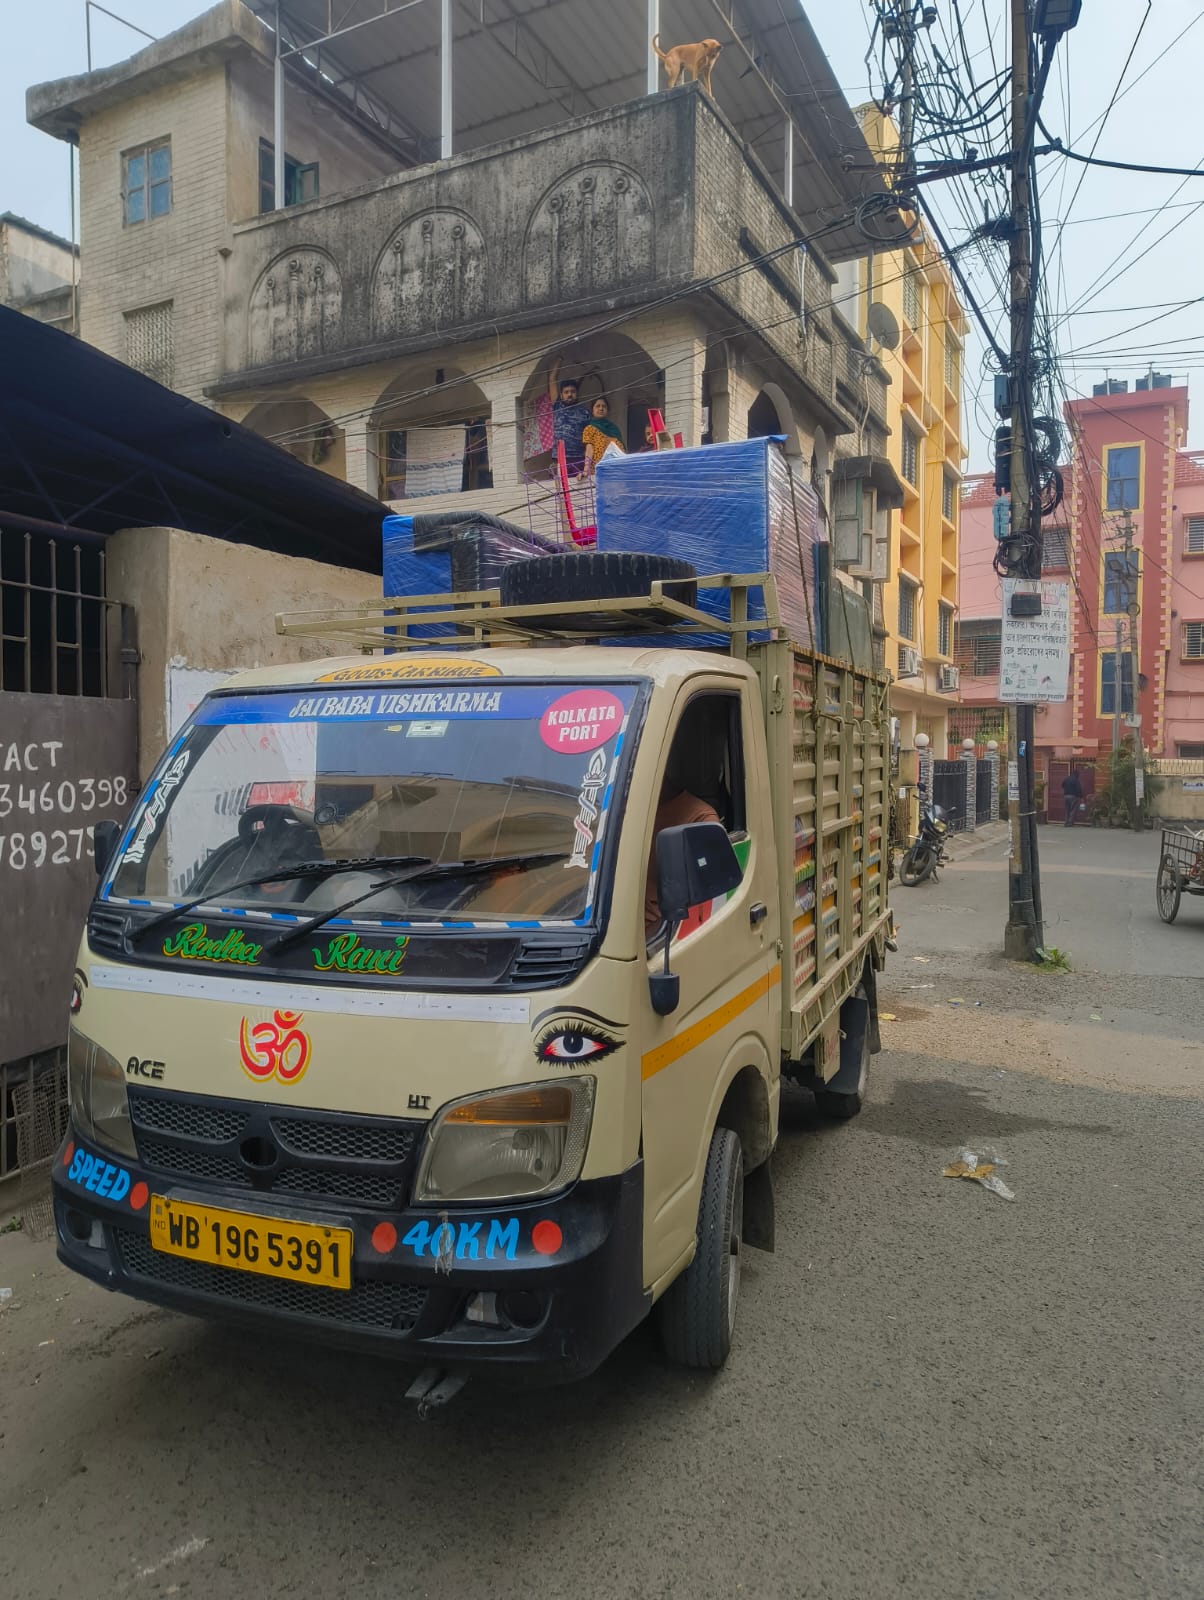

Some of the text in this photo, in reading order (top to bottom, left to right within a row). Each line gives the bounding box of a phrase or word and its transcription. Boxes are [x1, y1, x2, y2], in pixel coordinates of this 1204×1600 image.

[288, 691, 502, 718] JAI BABA VISHKARMA
[547, 705, 616, 726] KOLKATA
[559, 724, 601, 742] PORT
[0, 741, 63, 771] ACT
[163, 922, 410, 976] Radha Rani
[126, 1055, 166, 1080] ACE
[68, 1148, 131, 1202] SPEED
[152, 1218, 167, 1231] IND
[169, 1212, 340, 1278] WB 19G 5391
